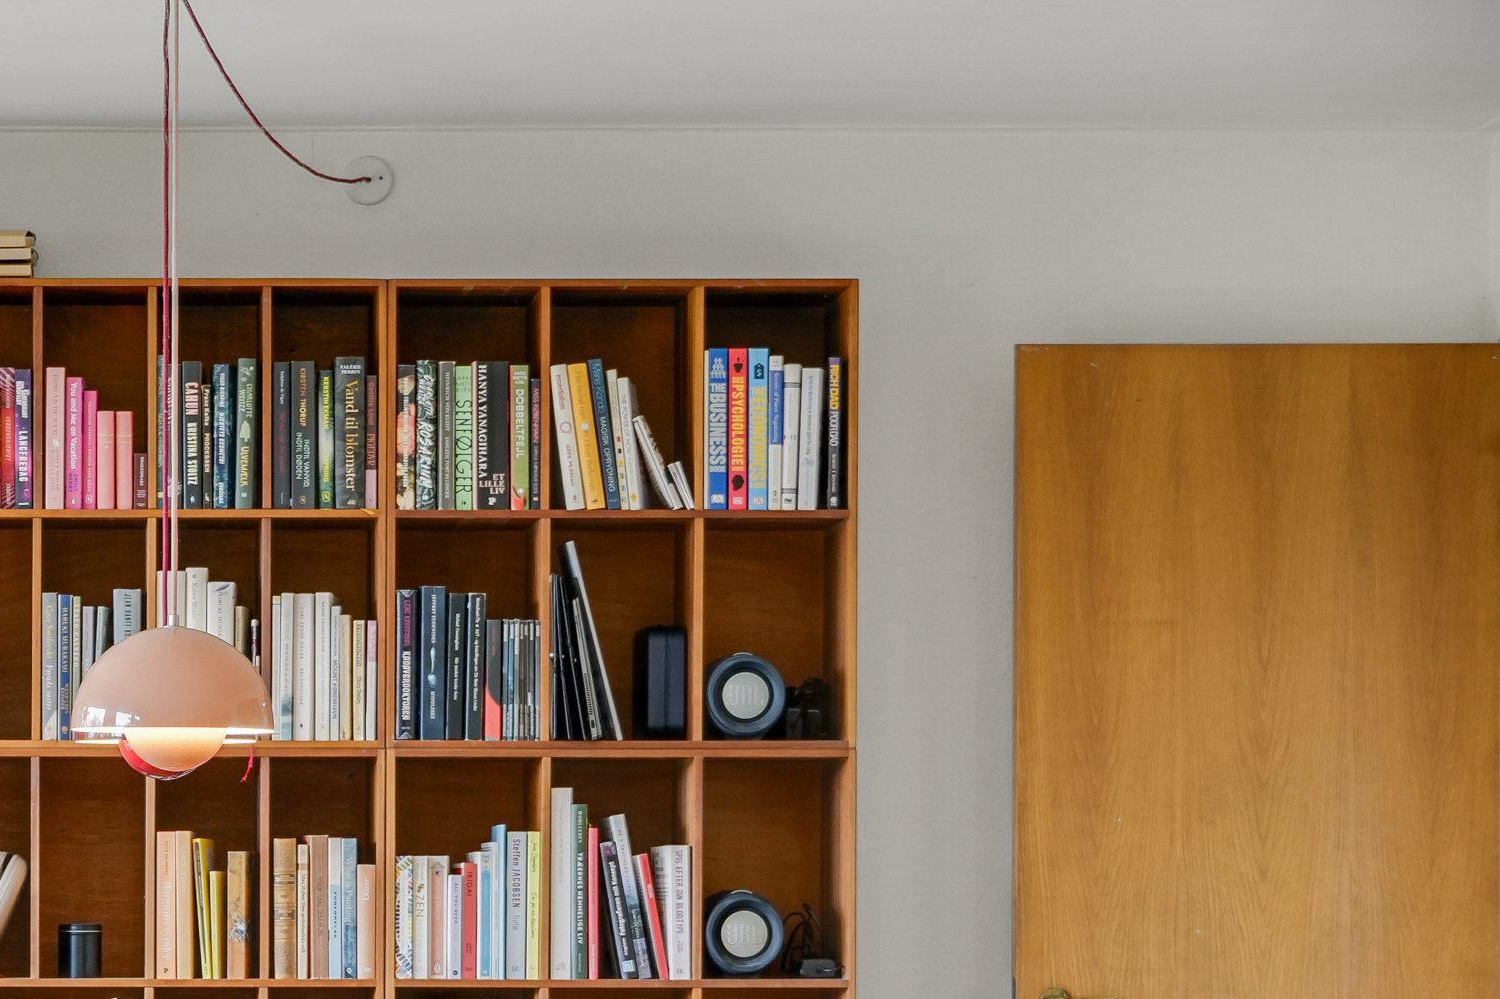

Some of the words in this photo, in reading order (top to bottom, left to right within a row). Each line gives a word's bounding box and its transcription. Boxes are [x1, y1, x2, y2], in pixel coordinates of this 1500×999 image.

[69, 382, 78, 397] You
[299, 367, 307, 396] KIRSTEN
[322, 376, 330, 404] KERSTIN
[478, 364, 487, 403] HANYA
[709, 383, 726, 392] THE
[829, 364, 839, 388] RICH
[69, 397, 78, 412] and
[185, 381, 199, 416] CAHUN
[345, 380, 358, 414] Vand
[596, 386, 605, 413] Kondo
[829, 388, 839, 410] DAD
[69, 413, 78, 425] Me
[299, 398, 307, 427] THORUP
[345, 416, 358, 429] til
[515, 389, 525, 459] DOBBELTFEJL
[731, 385, 744, 466] PSYCHOLOGIE
[829, 411, 839, 431] POOR
[69, 425, 78, 437] on
[186, 422, 198, 457] KRISTINA
[295, 432, 303, 453] INDTIL
[478, 404, 487, 478] YANAGIHARA
[599, 416, 610, 446] MAGISK
[624, 428, 630, 437] OF
[709, 392, 727, 465] BUSINESS
[751, 396, 767, 478] ECONOMICS
[829, 431, 839, 447] DAD
[19, 430, 29, 482] LANGFREDAG
[69, 437, 78, 470] Vacation
[302, 439, 310, 460] INDTIL
[367, 433, 376, 466] PIGEDYR
[418, 421, 434, 489] ROSARIUM
[456, 399, 472, 494] SENFØLGER
[186, 459, 198, 486] STOLTZ
[239, 445, 250, 487] ULVEMÆLK
[295, 454, 303, 480] DØDEN
[345, 433, 358, 491] blomster
[603, 448, 615, 493] OPRYDNING
[479, 480, 505, 488] LILLE
[492, 473, 505, 481] ET
[123, 593, 132, 608] JEAN
[61, 606, 69, 634] HARUKI
[61, 635, 69, 673] MURAKAMI
[403, 651, 411, 721] KADAVERDOKTOREN
[728, 685, 764, 706] JBL
[511, 838, 521, 866] Steffen
[675, 849, 683, 864] SPIS
[343, 880, 354, 888] is
[511, 868, 521, 908] JACOBSEN
[675, 866, 683, 887] EFTER
[343, 889, 354, 926] Painting?
[414, 894, 425, 918] ZEN
[675, 889, 683, 900] DIN
[675, 902, 683, 935] BLODTYPE
[727, 924, 764, 945] JBL
